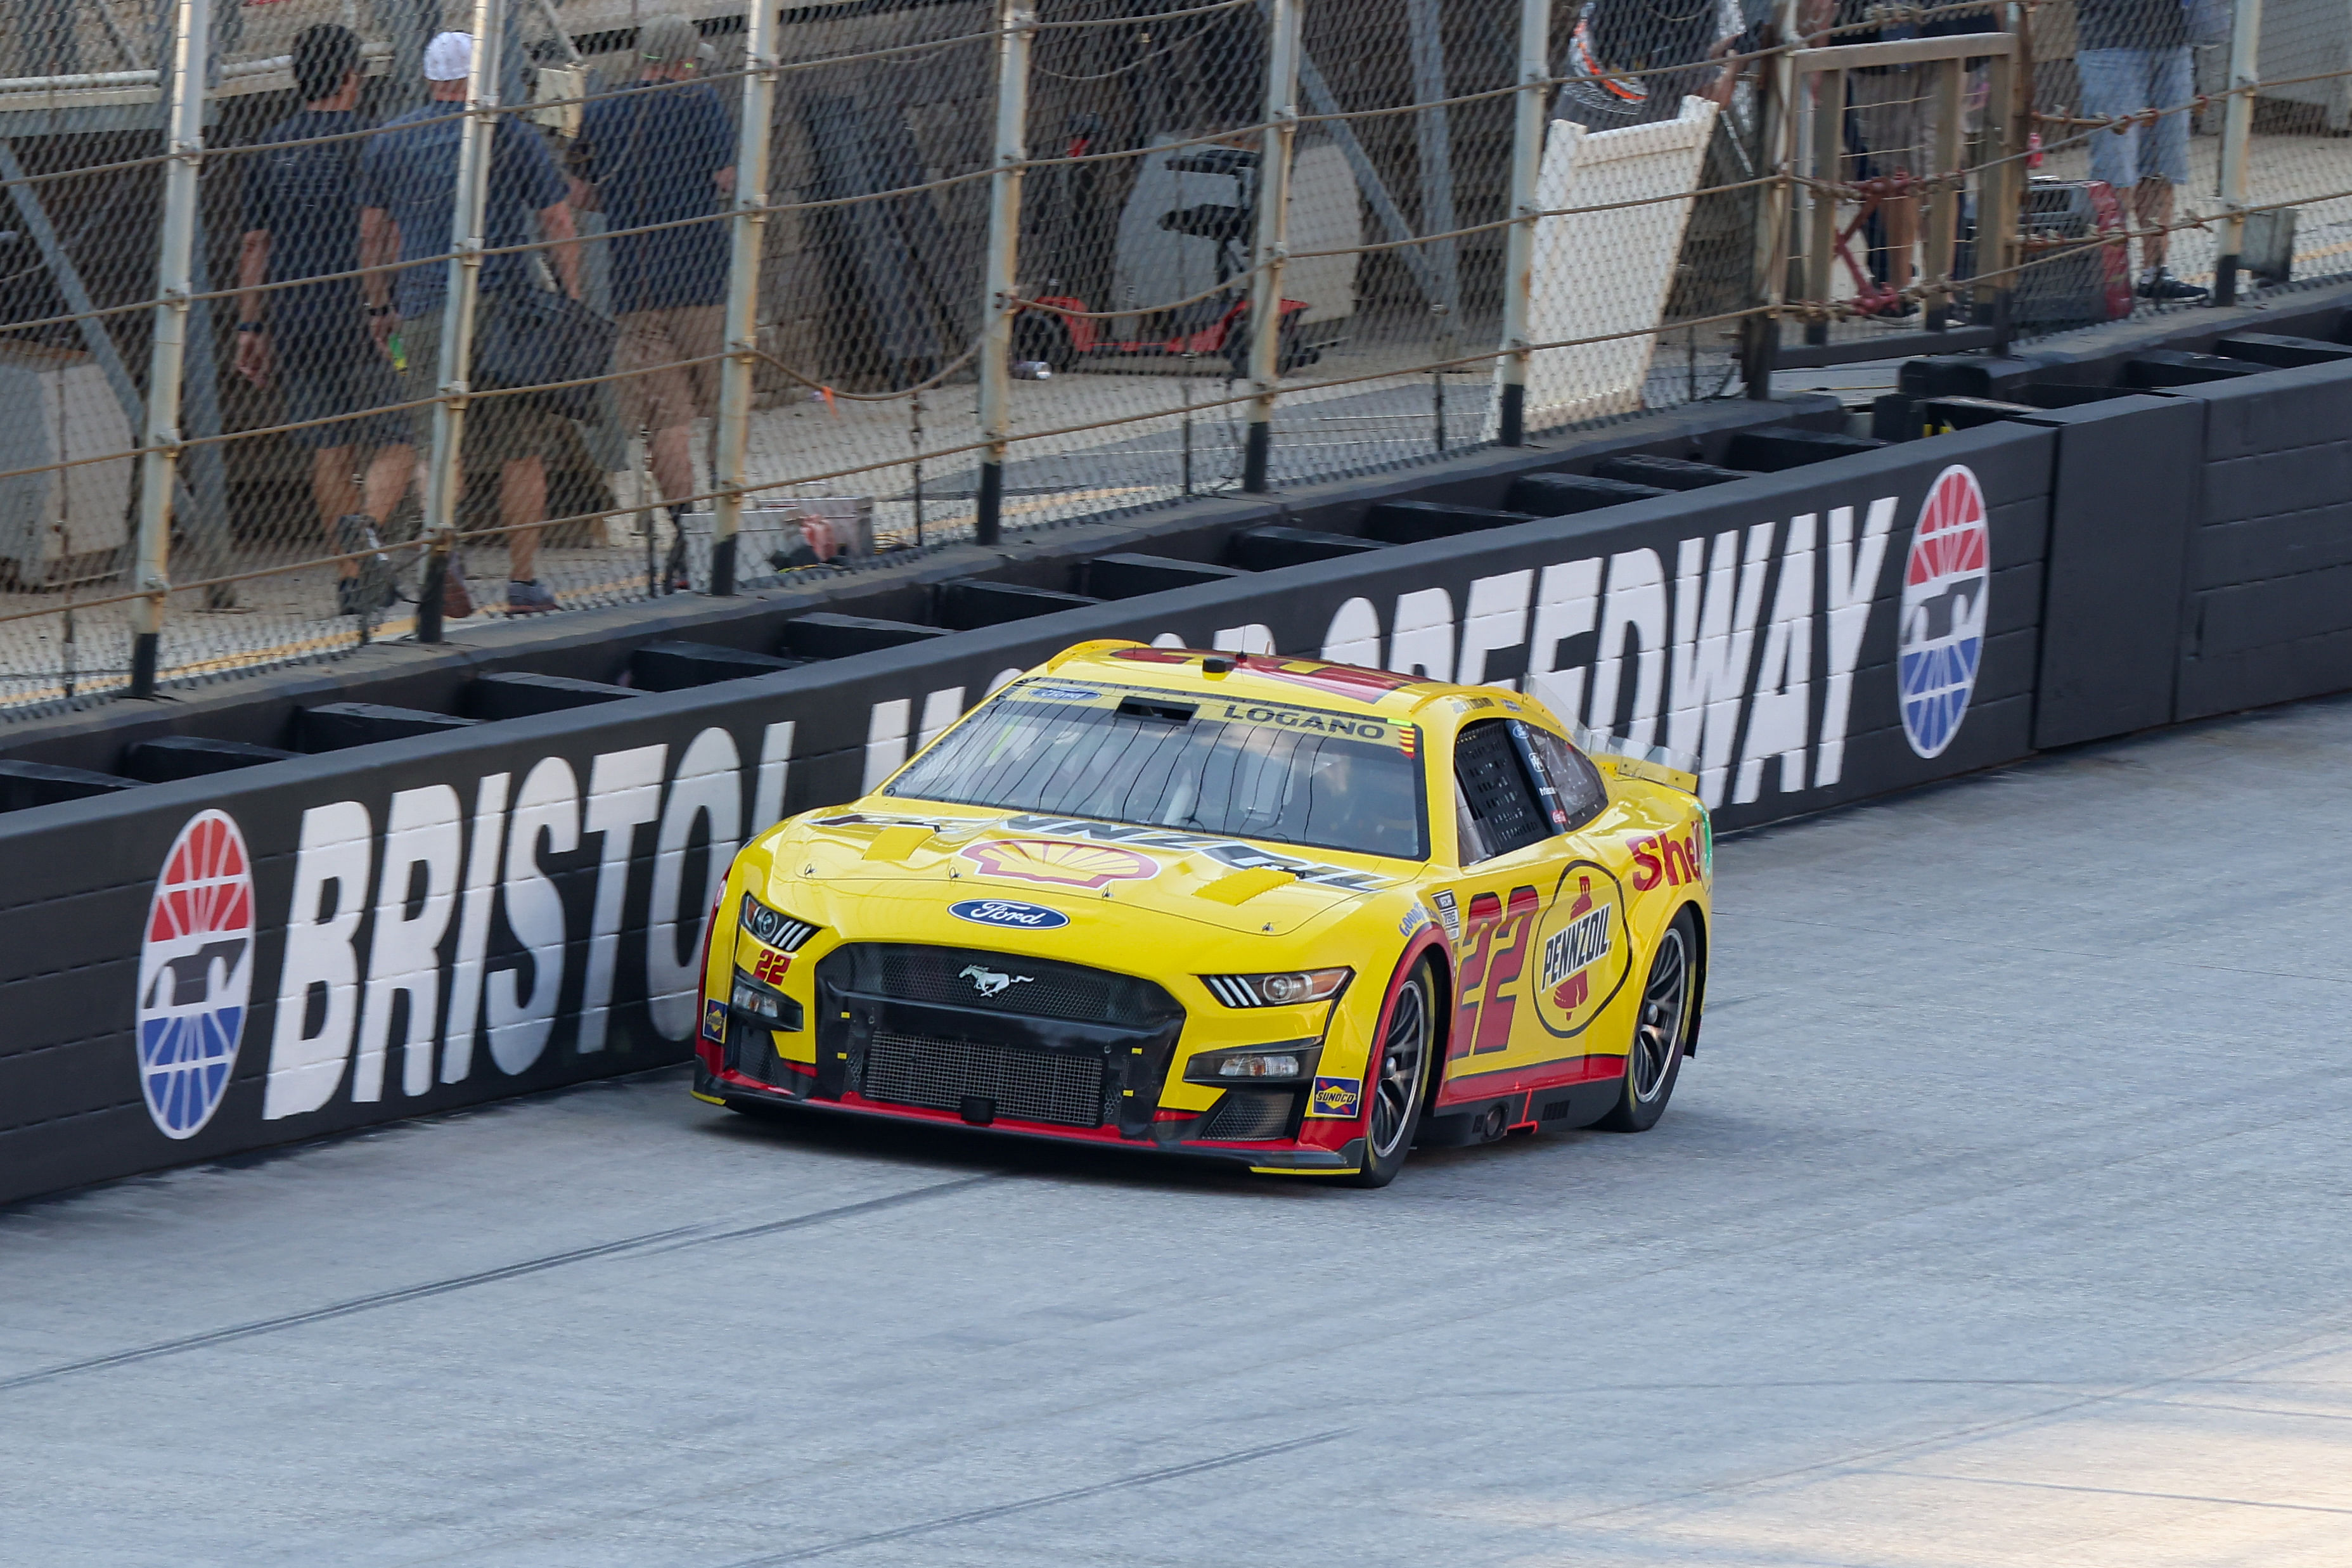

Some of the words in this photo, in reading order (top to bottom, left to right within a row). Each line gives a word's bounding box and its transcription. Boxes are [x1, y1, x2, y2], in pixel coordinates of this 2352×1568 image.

[1223, 704, 1385, 740] LOGANO
[1625, 820, 1701, 892] She
[752, 949, 792, 986] 22
[1449, 884, 1539, 1061] 22
[1541, 903, 1611, 993] PENNZOIL
[1316, 1091, 1355, 1103] SUNOCO
